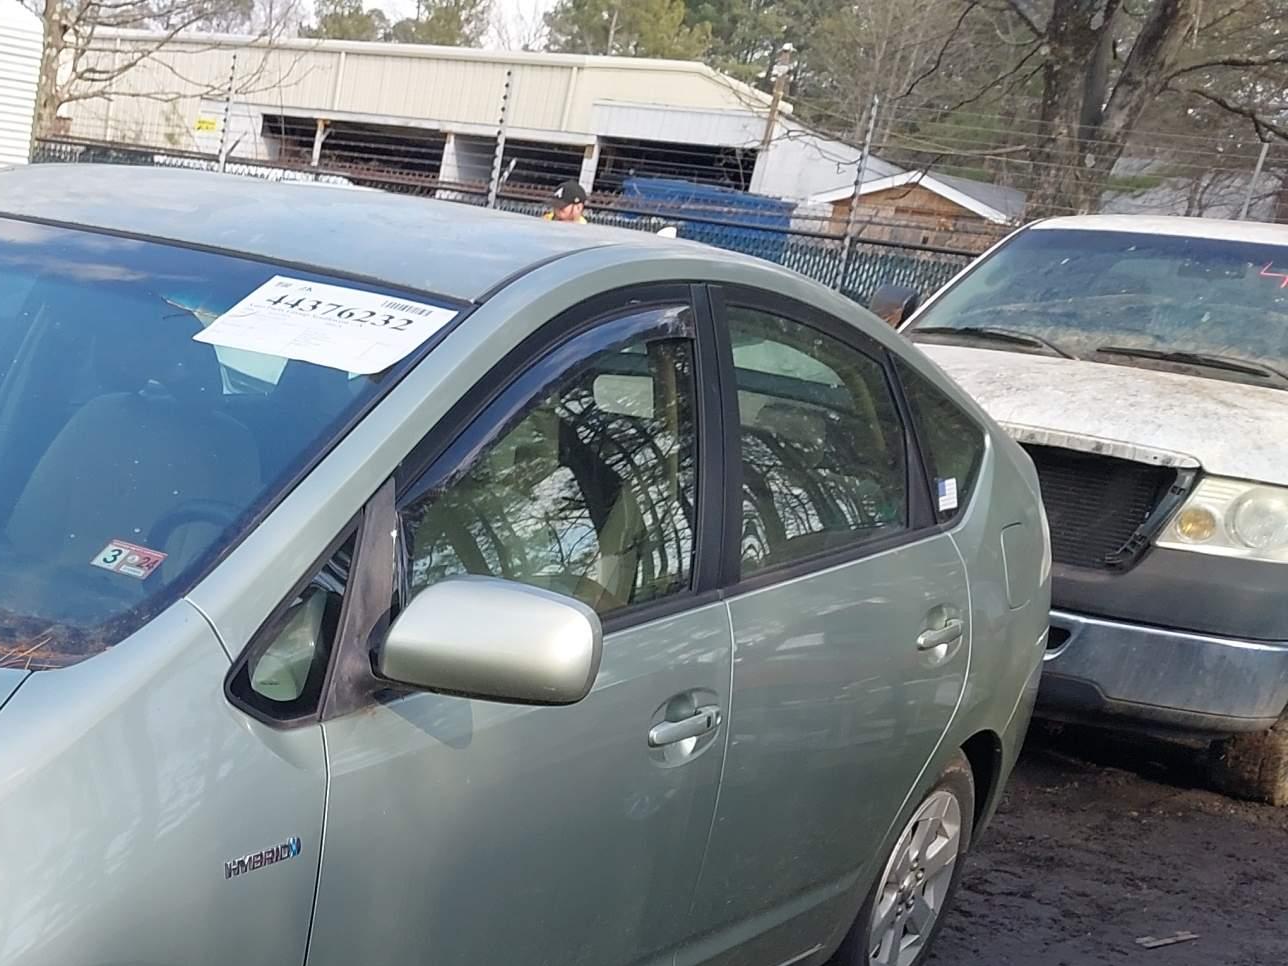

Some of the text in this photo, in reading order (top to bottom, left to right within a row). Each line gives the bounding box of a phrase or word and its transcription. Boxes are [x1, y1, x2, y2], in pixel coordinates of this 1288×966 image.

[266, 294, 415, 332] 44376232
[102, 548, 123, 564] 3
[224, 843, 291, 880] HYBRID
